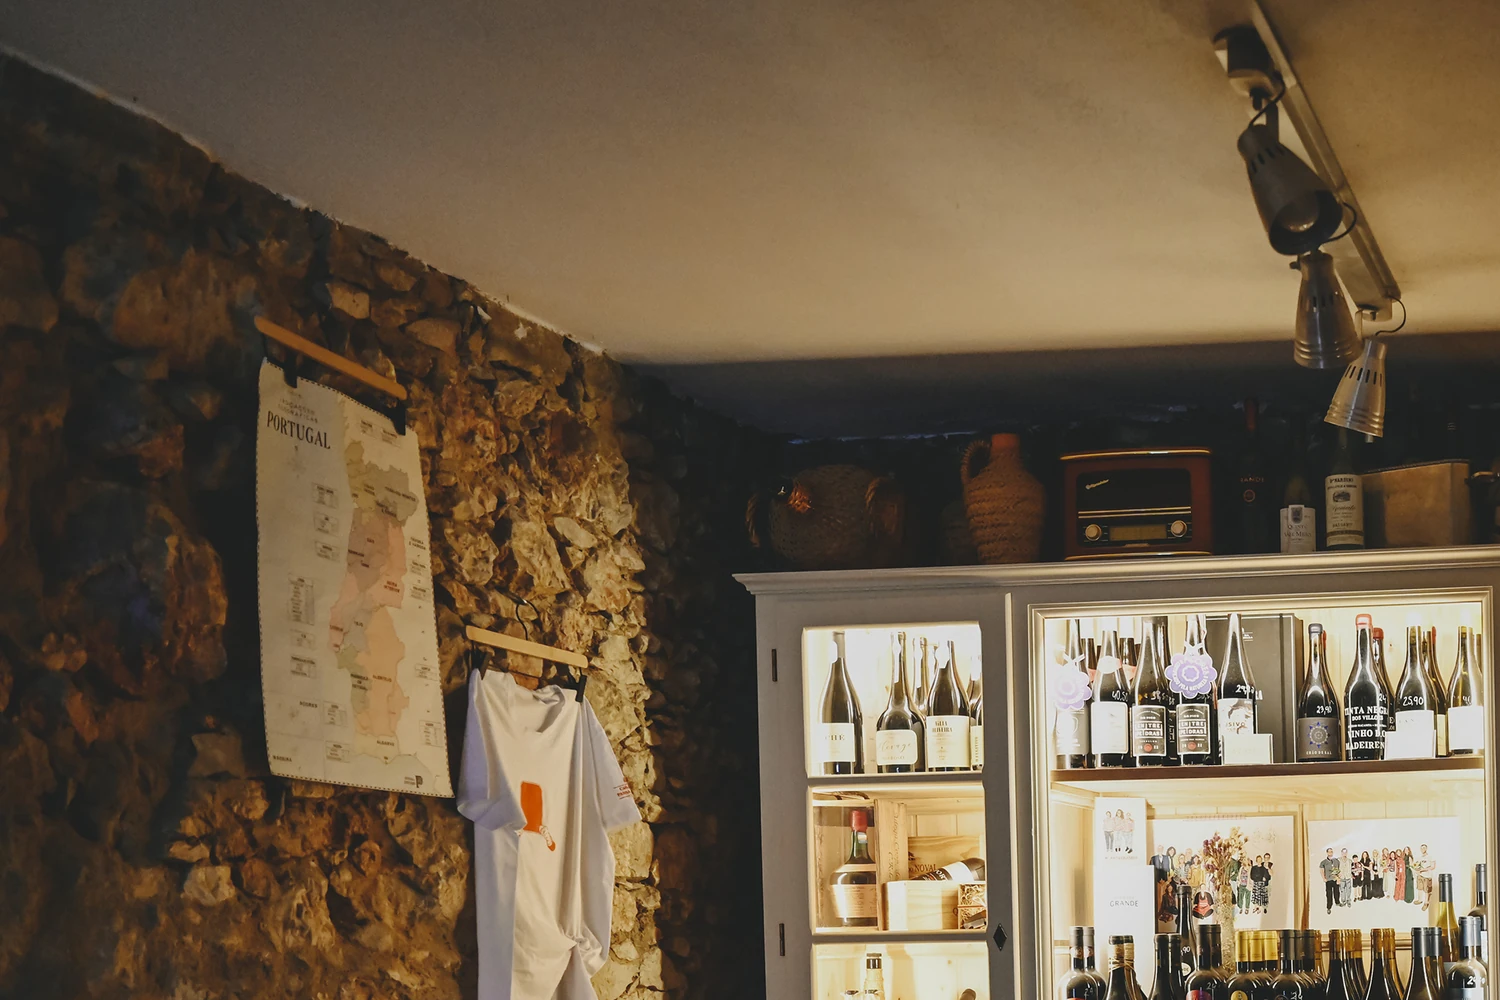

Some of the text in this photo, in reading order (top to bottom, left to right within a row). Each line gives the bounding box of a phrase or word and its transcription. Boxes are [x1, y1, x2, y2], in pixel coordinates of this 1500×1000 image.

[266, 410, 331, 449] PORTUGAL
[1366, 705, 1388, 715] NEGR
[1347, 729, 1373, 738] VINHO
[1345, 741, 1385, 751] MADEIREN
